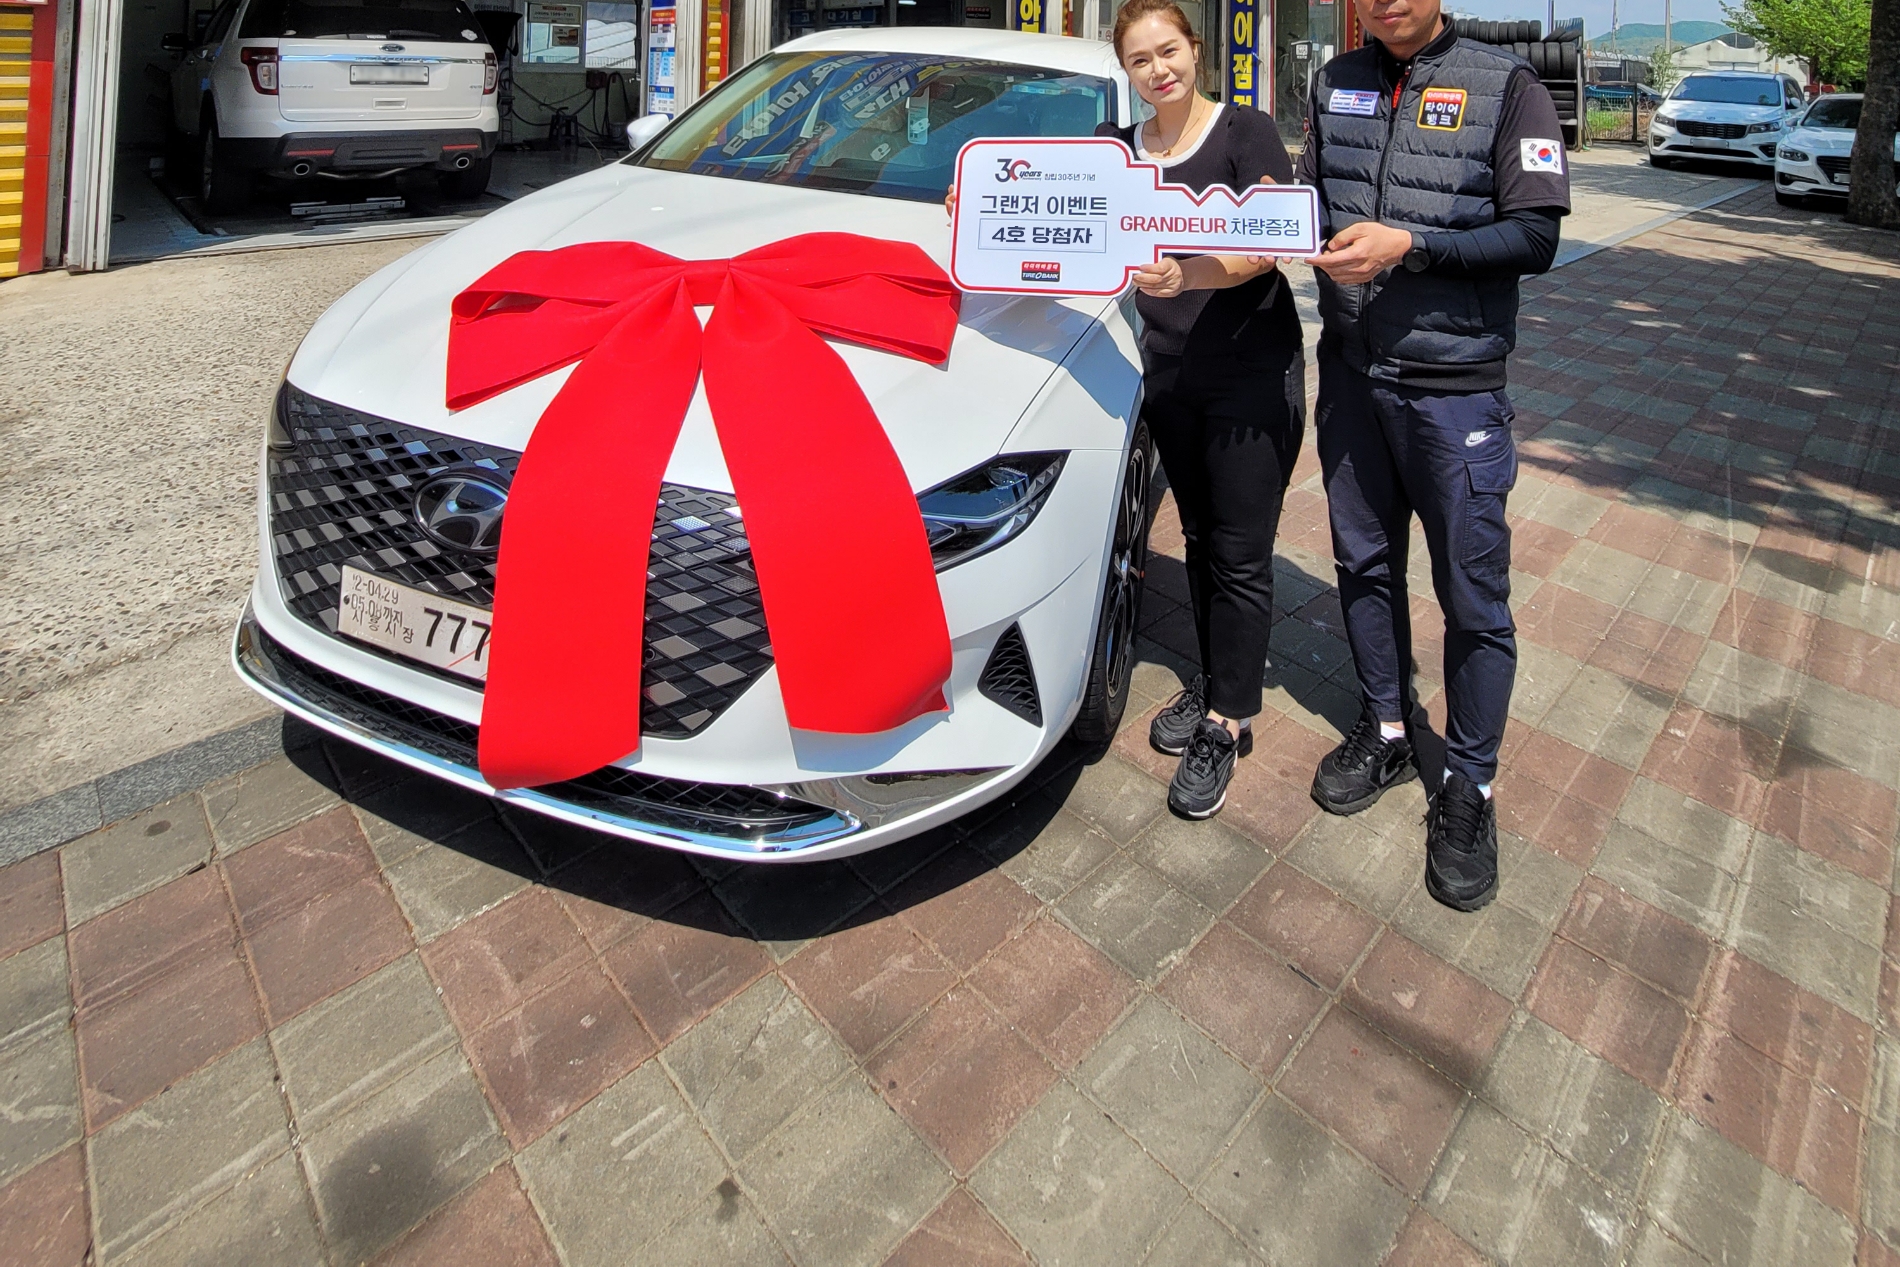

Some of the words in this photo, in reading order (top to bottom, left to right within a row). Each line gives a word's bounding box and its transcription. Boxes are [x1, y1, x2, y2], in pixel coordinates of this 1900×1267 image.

[1425, 102, 1459, 115] 타이어
[1426, 113, 1452, 126] 뱅크
[1018, 170, 1042, 179] years
[1057, 173, 1080, 182] 30주년
[1081, 173, 1096, 182] 기념
[980, 195, 1039, 215] 그랜저
[1046, 195, 1108, 216] 이벤트
[1120, 215, 1228, 234] GRANDEUR
[1230, 217, 1300, 237] 차량증정
[991, 225, 1026, 243] 4호
[1032, 226, 1093, 245] 당첨자
[1468, 430, 1487, 441] NIKE
[352, 573, 399, 605] 2-04.29
[423, 606, 492, 662] 777
